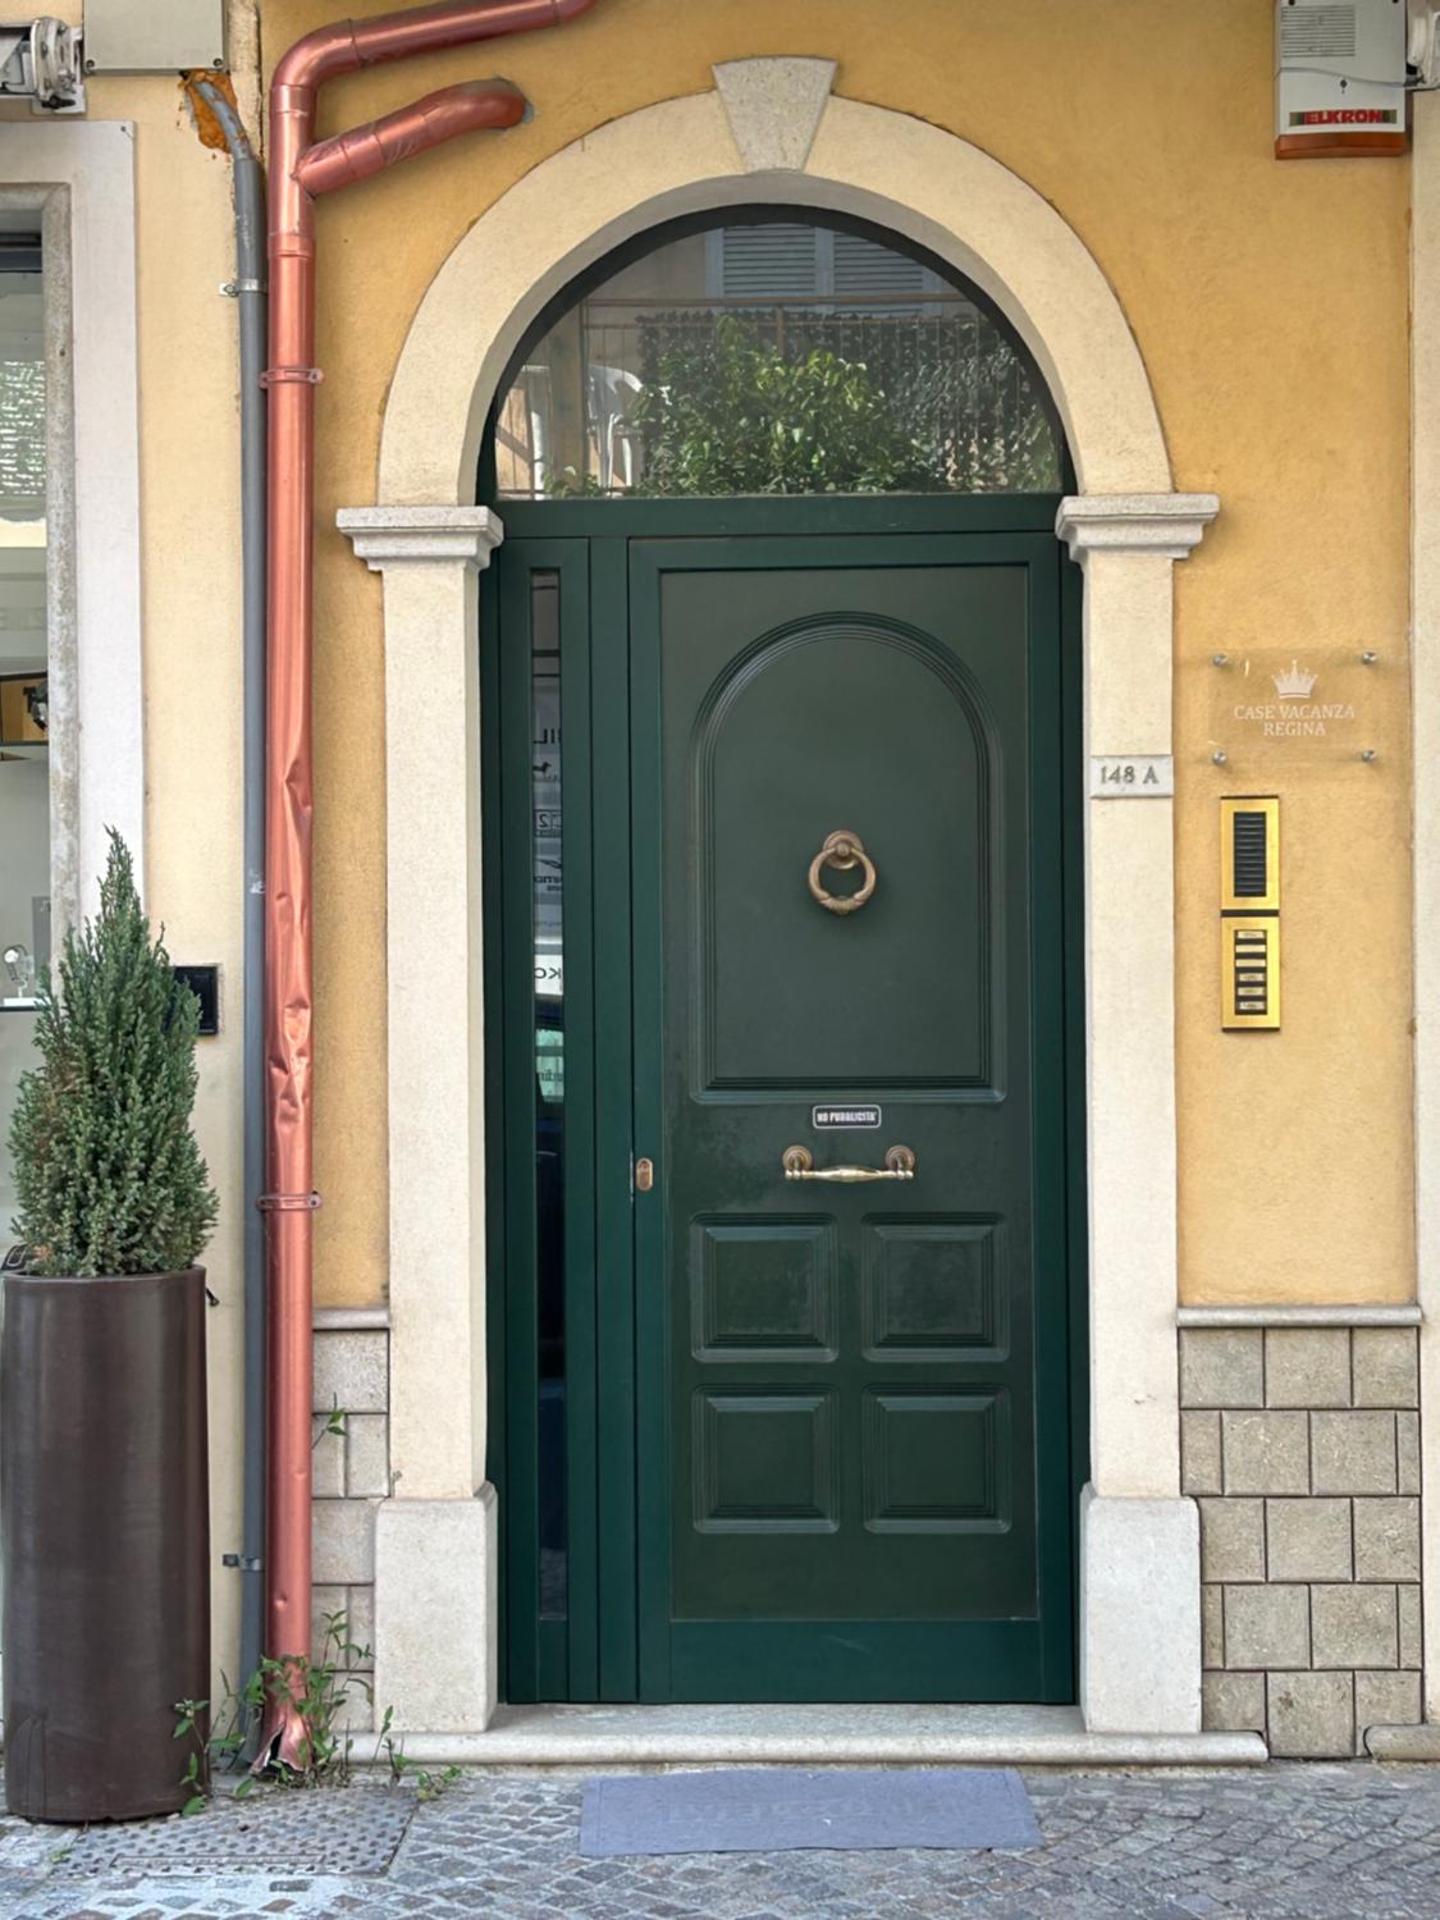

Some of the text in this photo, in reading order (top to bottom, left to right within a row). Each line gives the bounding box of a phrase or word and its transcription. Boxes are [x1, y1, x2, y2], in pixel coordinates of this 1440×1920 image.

[1305, 110, 1382, 125] ELKRON
[1234, 704, 1355, 719] CASE VACANZA
[1264, 722, 1326, 736] REGINA
[1101, 765, 1159, 784] 148 A
